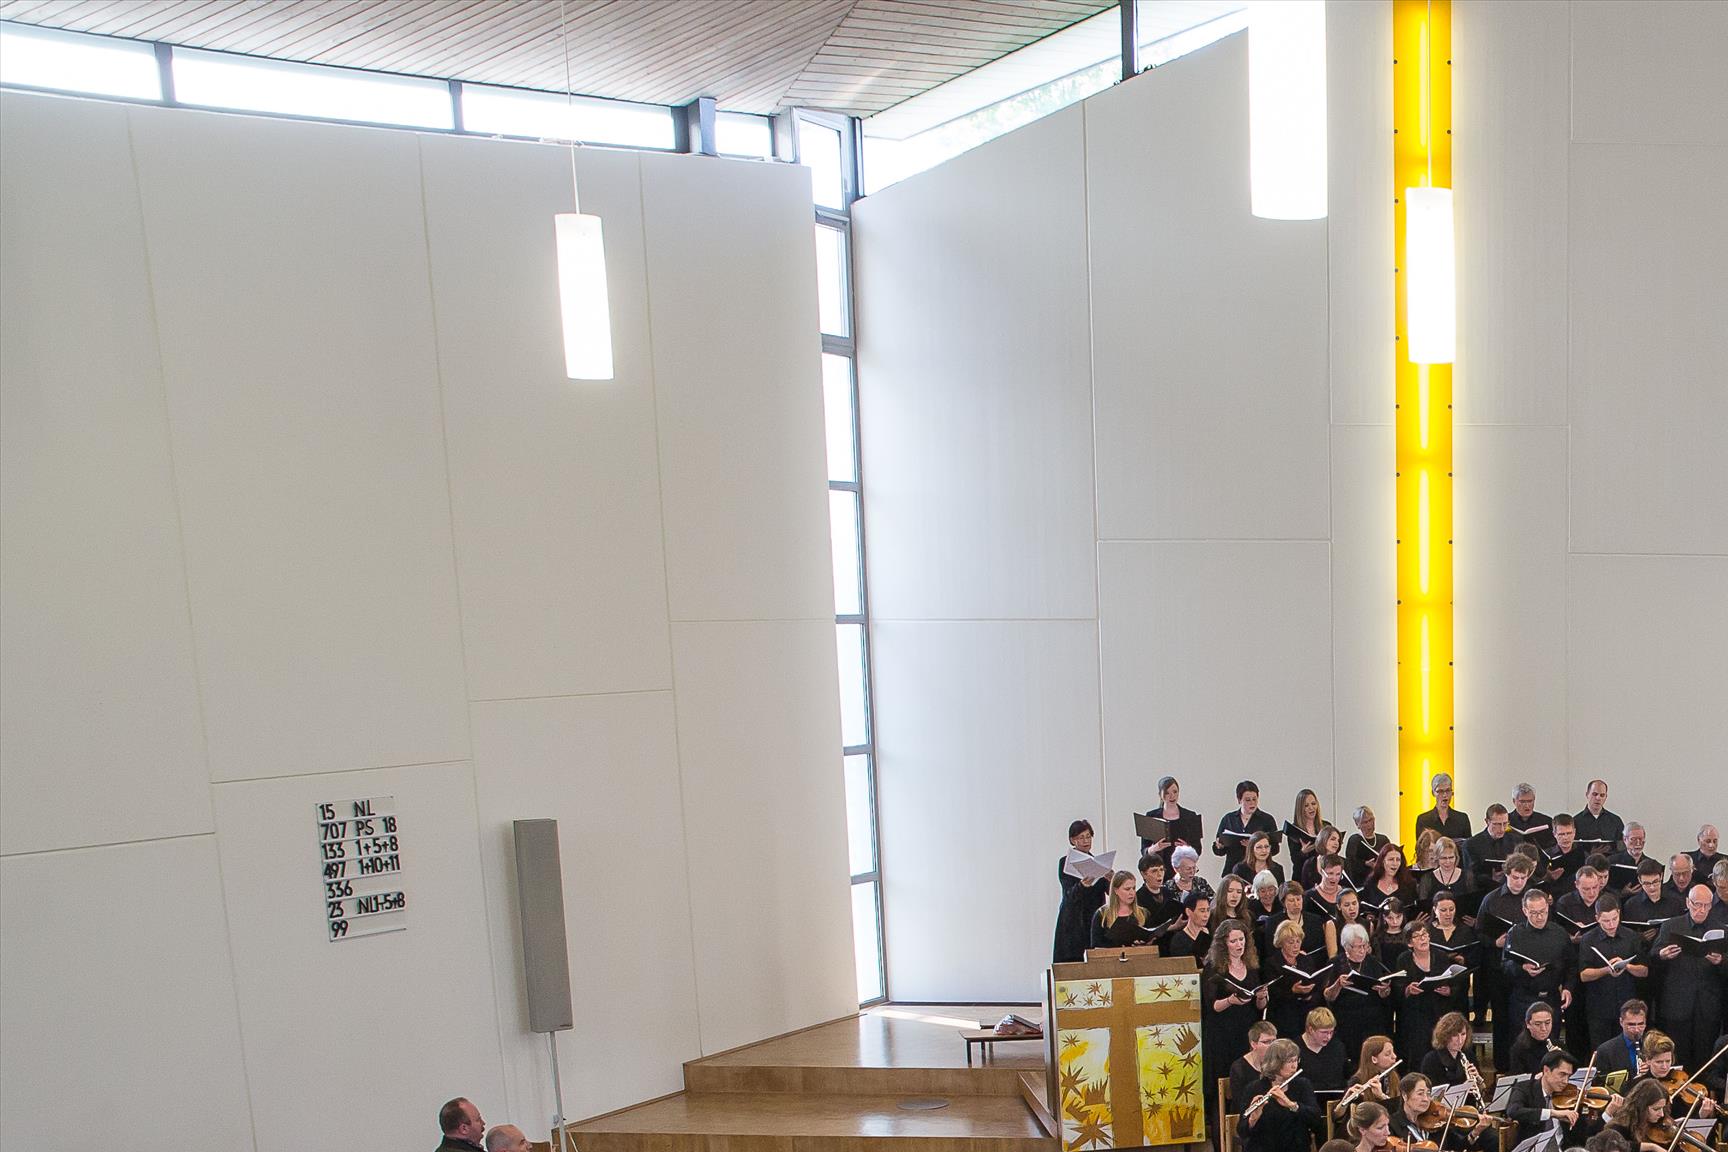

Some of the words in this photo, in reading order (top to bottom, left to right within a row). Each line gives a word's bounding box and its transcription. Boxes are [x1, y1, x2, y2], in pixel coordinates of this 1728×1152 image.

[320, 804, 335, 820] 15
[354, 800, 375, 817] NL
[321, 822, 347, 840] 707
[355, 820, 374, 836] PS
[383, 817, 397, 833] 18
[322, 842, 345, 859] 133
[324, 862, 346, 879] 497
[327, 880, 353, 899] 336
[328, 902, 344, 918] 23
[332, 920, 348, 938] 99
